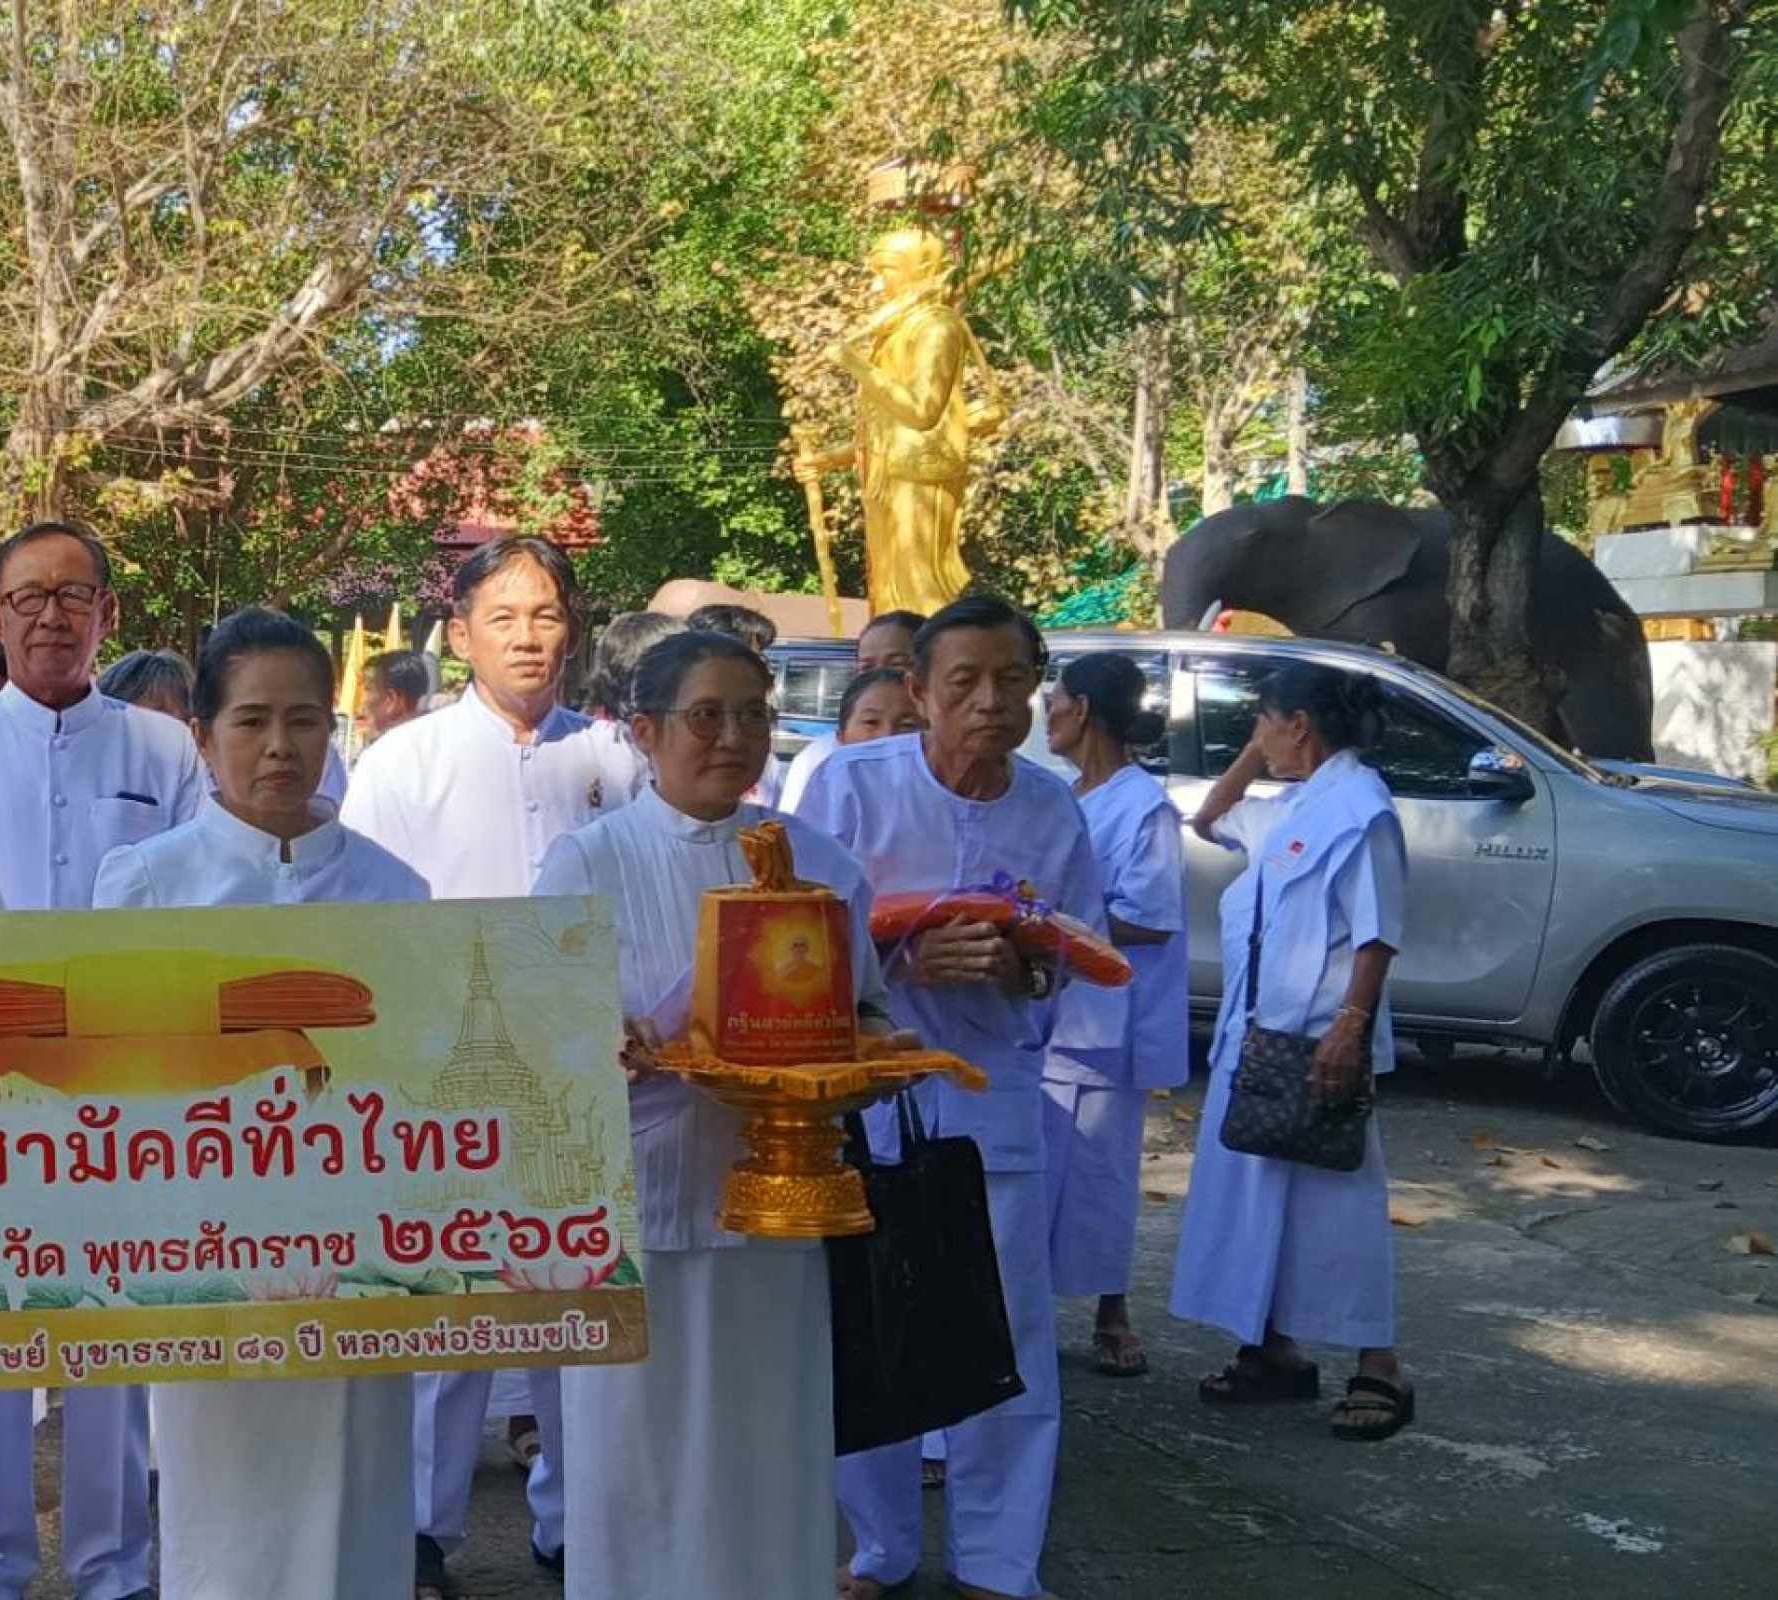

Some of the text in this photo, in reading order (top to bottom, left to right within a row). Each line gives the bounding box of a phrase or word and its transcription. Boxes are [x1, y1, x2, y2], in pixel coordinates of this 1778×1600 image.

[1473, 842, 1550, 861] HILUX
[1, 1226, 66, 1278] วัด
[83, 1219, 356, 1294] พุทธศักราช
[378, 1205, 610, 1265] ๒๕๖๘
[60, 1339, 221, 1378] บูชาธรรม
[236, 1336, 285, 1362] ๘๑
[298, 1321, 323, 1358] ปี
[336, 1313, 608, 1357] หลวงพ่อธัมมชโย
